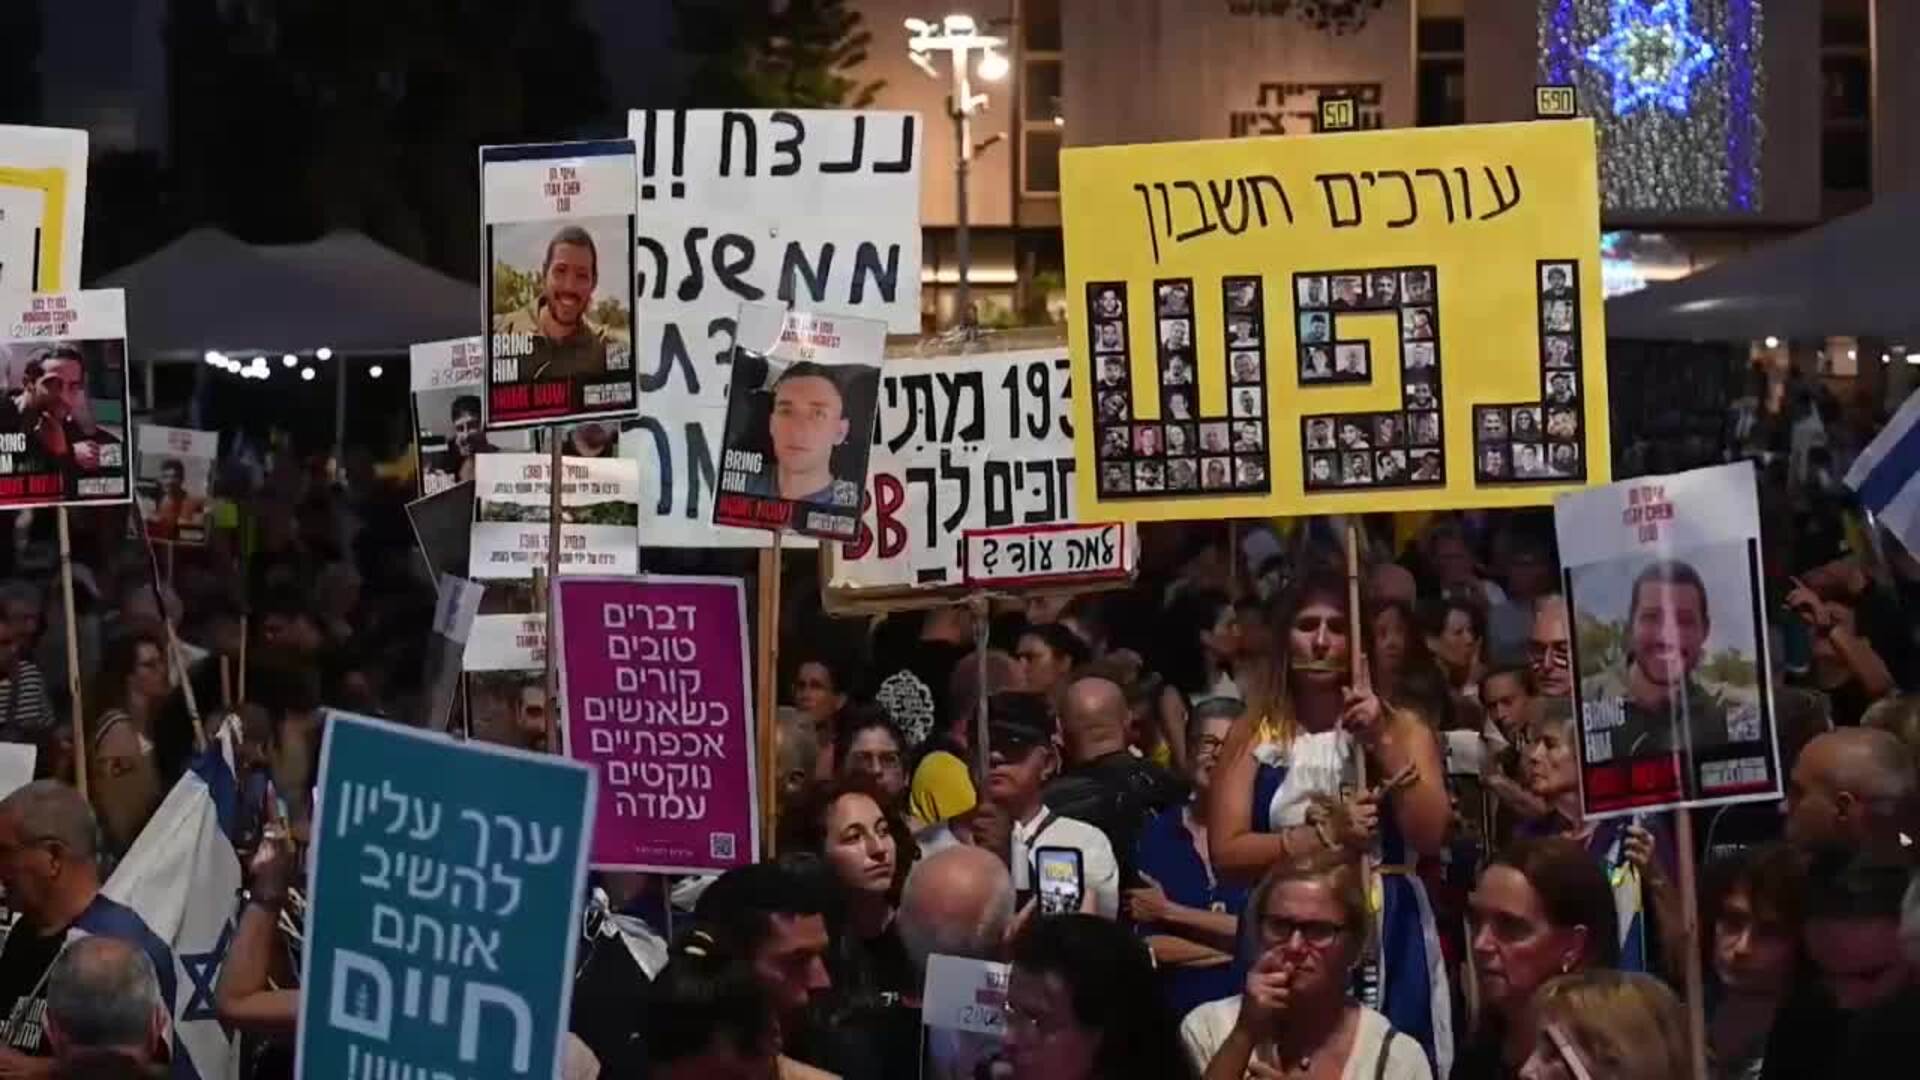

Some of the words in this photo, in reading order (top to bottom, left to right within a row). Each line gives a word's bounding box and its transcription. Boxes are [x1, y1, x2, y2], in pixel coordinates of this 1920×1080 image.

[1313, 164, 1521, 230] עורכים
[1134, 172, 1295, 264] חשבון
[637, 227, 901, 305] ממשלה
[493, 332, 534, 357] BRING
[492, 356, 519, 384] HIM
[724, 448, 764, 474] BRING
[721, 469, 747, 493] HIM
[603, 602, 697, 630] דברים
[608, 634, 697, 662] טובים
[616, 666, 701, 700] קורים
[584, 696, 730, 727] כשאנשים
[591, 728, 726, 759] אכפתיים
[608, 760, 713, 796] נוקטים
[336, 779, 442, 841] עליון
[616, 791, 707, 820] עמדה
[461, 809, 563, 869] ערך
[360, 844, 522, 915] להשיב
[371, 903, 501, 972] אותם
[328, 948, 534, 1075] חיים
